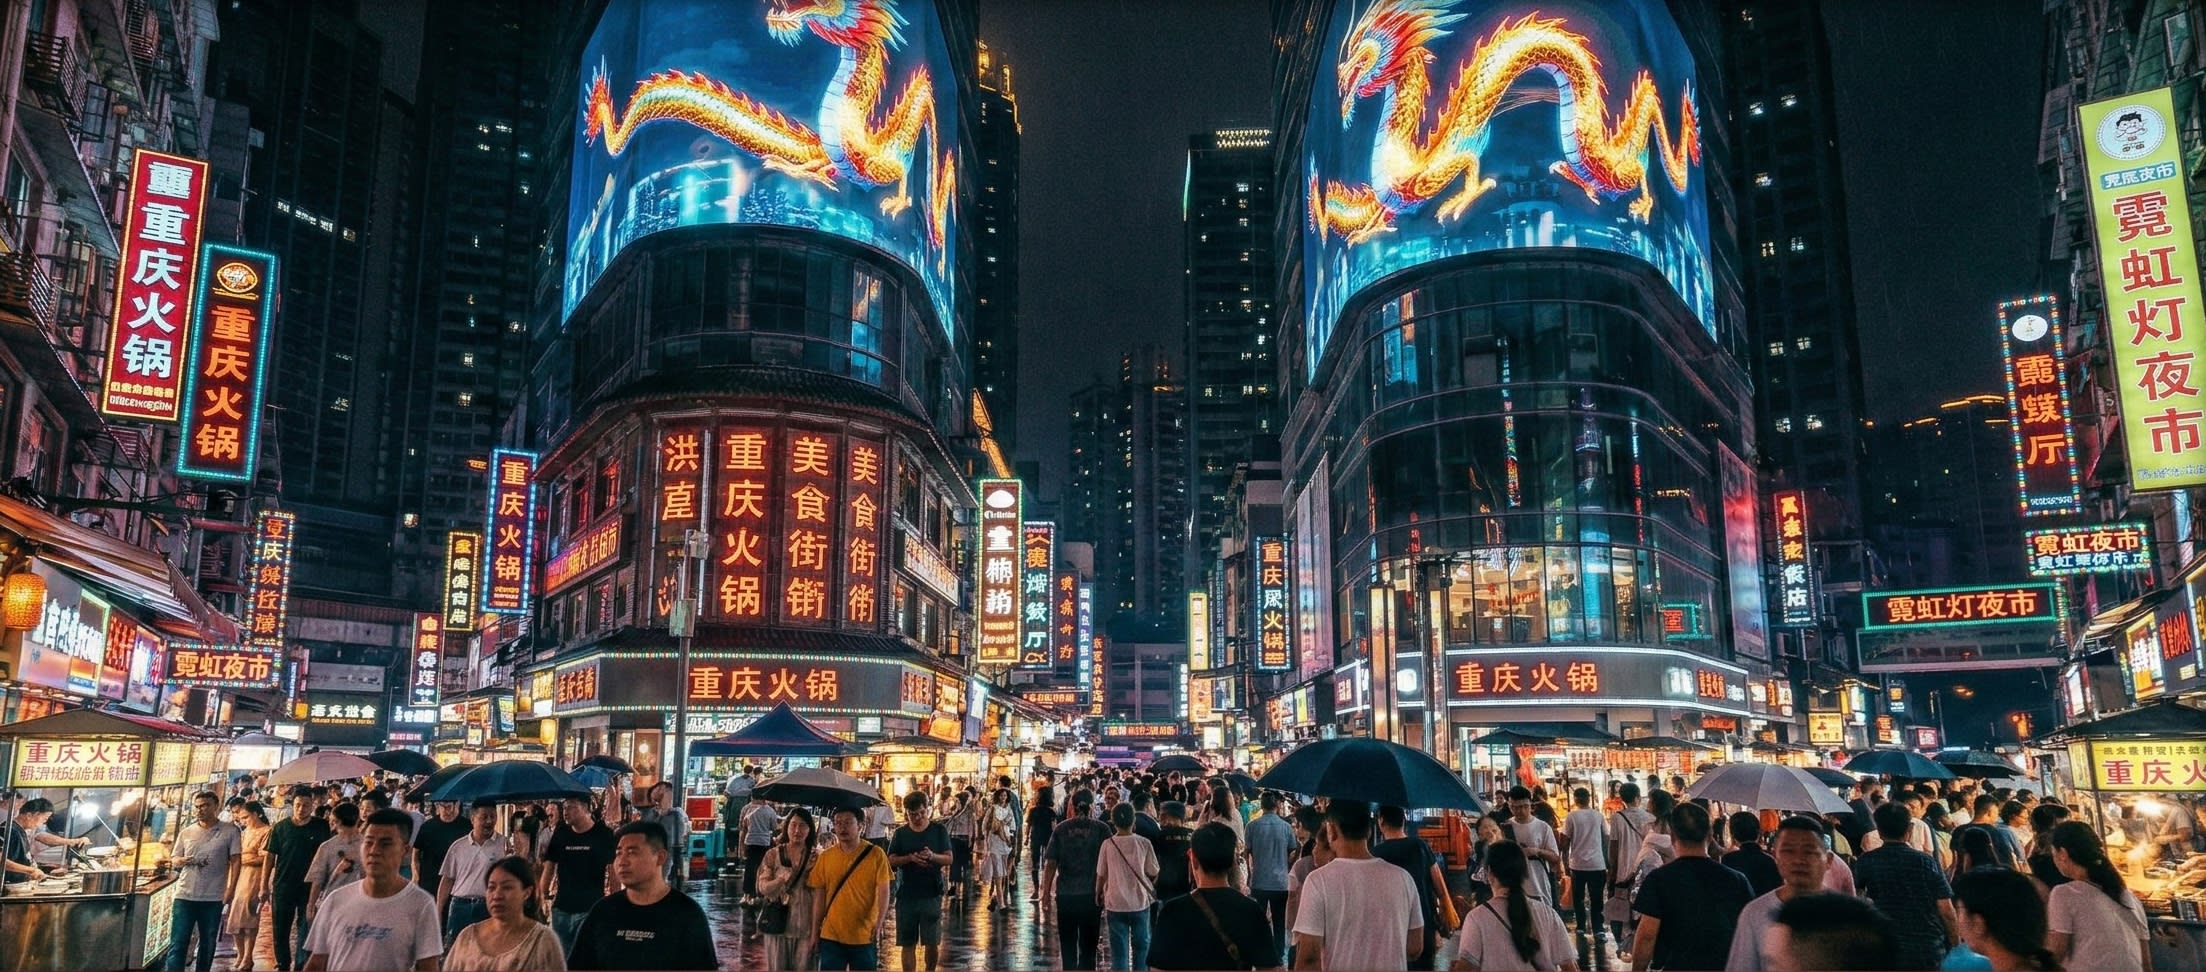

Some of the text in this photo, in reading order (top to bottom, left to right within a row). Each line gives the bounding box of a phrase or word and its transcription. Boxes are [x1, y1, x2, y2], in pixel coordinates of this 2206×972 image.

[2112, 190, 2203, 455] 霓虹灯夜市
[196, 305, 256, 460] 重庆火锅
[495, 461, 529, 581] 重庆火锅
[720, 433, 767, 616] 重庆火锅
[2034, 529, 2139, 556] 霓虹夜市
[1888, 589, 2037, 623] 霓虹灯夜市
[173, 652, 272, 681] 霓虹夜市
[1455, 661, 1598, 694] 重庆火锅
[689, 667, 837, 701] 重庆火锅
[25, 742, 142, 764] 重庆火锅
